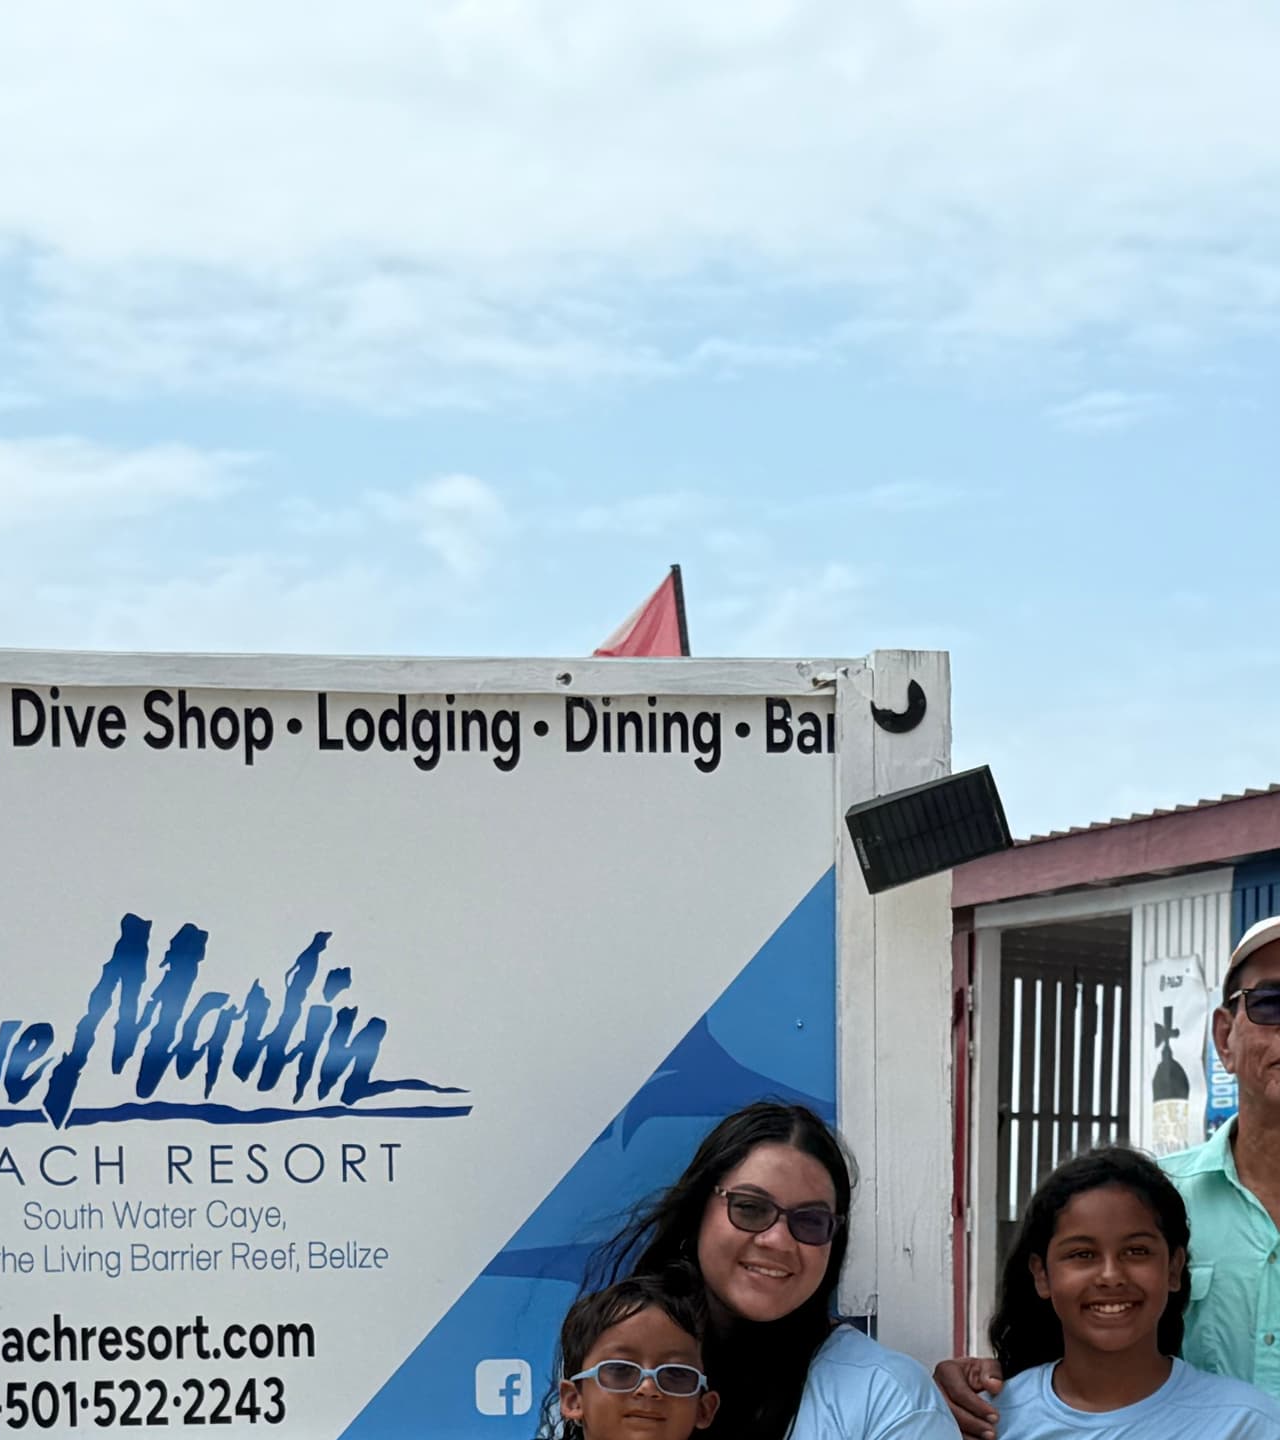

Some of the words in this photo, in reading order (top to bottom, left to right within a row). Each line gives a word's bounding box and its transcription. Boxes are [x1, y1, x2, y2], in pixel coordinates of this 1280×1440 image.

[12, 687, 127, 748] Dive
[143, 689, 275, 765] Shop
[318, 692, 521, 771] Lodging
[565, 696, 722, 774] Dining
[42, 913, 471, 1130] Marlin
[168, 1143, 403, 1184] RESORT
[23, 1200, 104, 1231] South
[113, 1200, 197, 1230] Water
[206, 1199, 287, 1234] Caye,
[44, 1243, 122, 1278] Living
[130, 1243, 223, 1272] Barrier
[231, 1241, 300, 1273] Reef,
[308, 1240, 390, 1270] Belize
